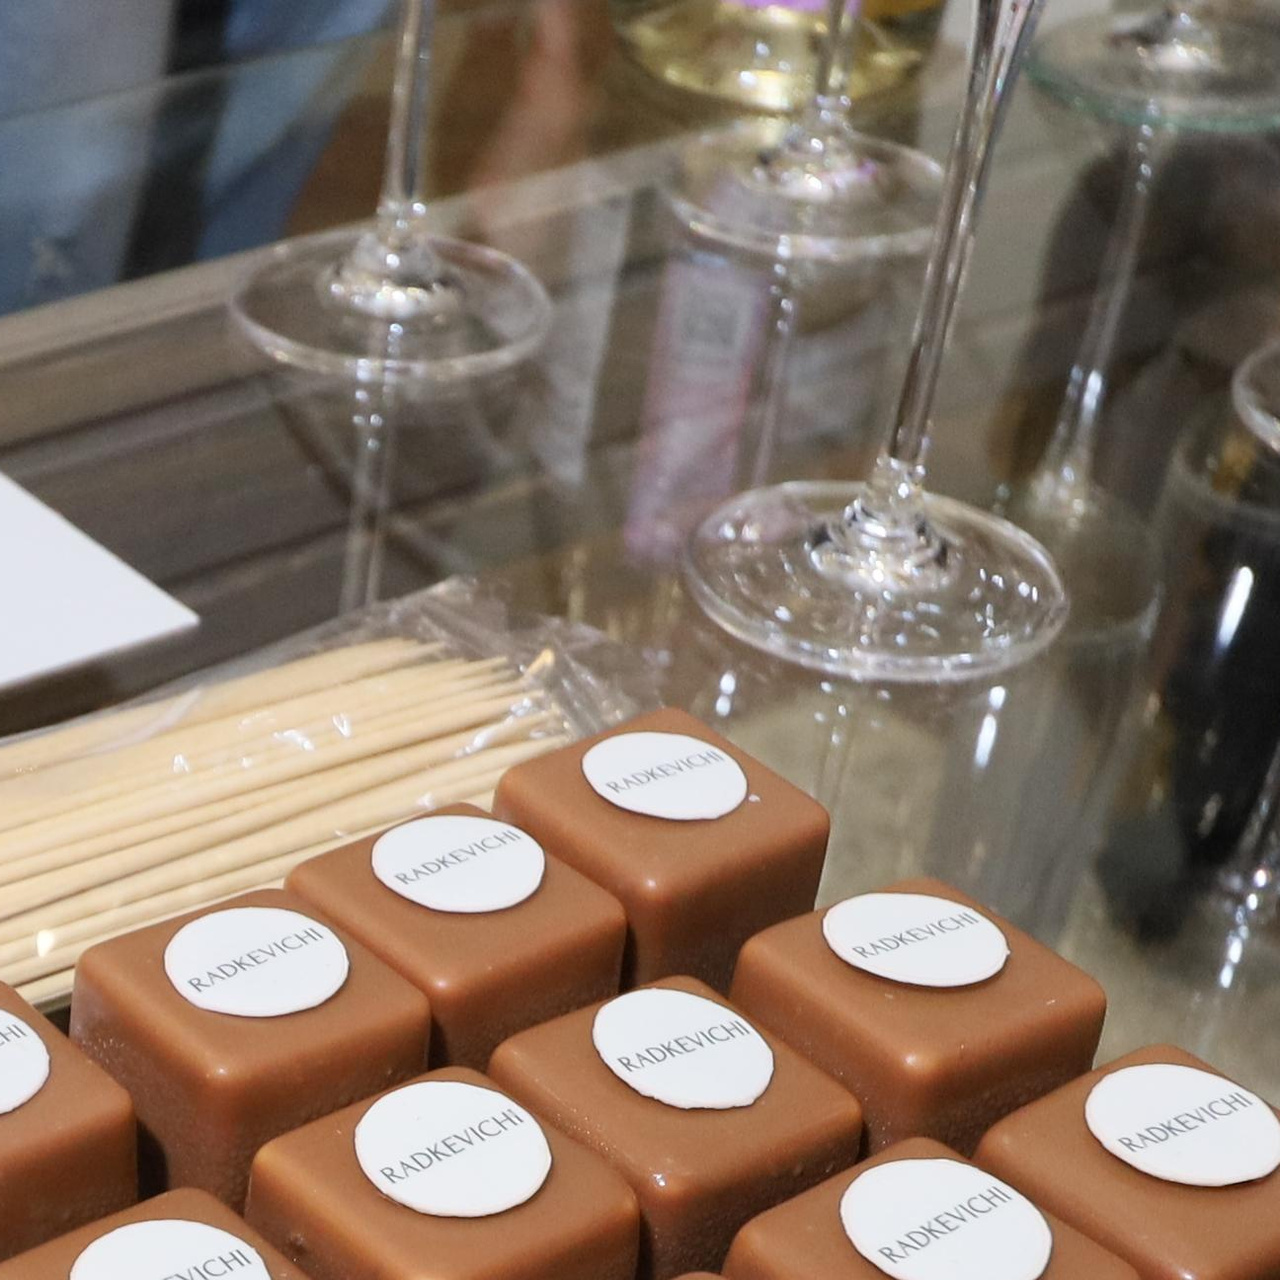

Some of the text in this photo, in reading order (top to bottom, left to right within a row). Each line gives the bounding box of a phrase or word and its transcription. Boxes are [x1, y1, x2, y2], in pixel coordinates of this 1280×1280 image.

[605, 750, 725, 793] RADKEVICHI
[394, 831, 522, 885] RADKEVICHI
[187, 928, 325, 993] RADKEVICHI
[852, 913, 980, 958] RADKEVICHI
[617, 1020, 750, 1072] RADKEVICHI
[380, 1109, 525, 1184] RADKEVICHI
[1118, 1092, 1254, 1152] RADKEVICHI
[878, 1186, 1013, 1264] RADKEVICHI
